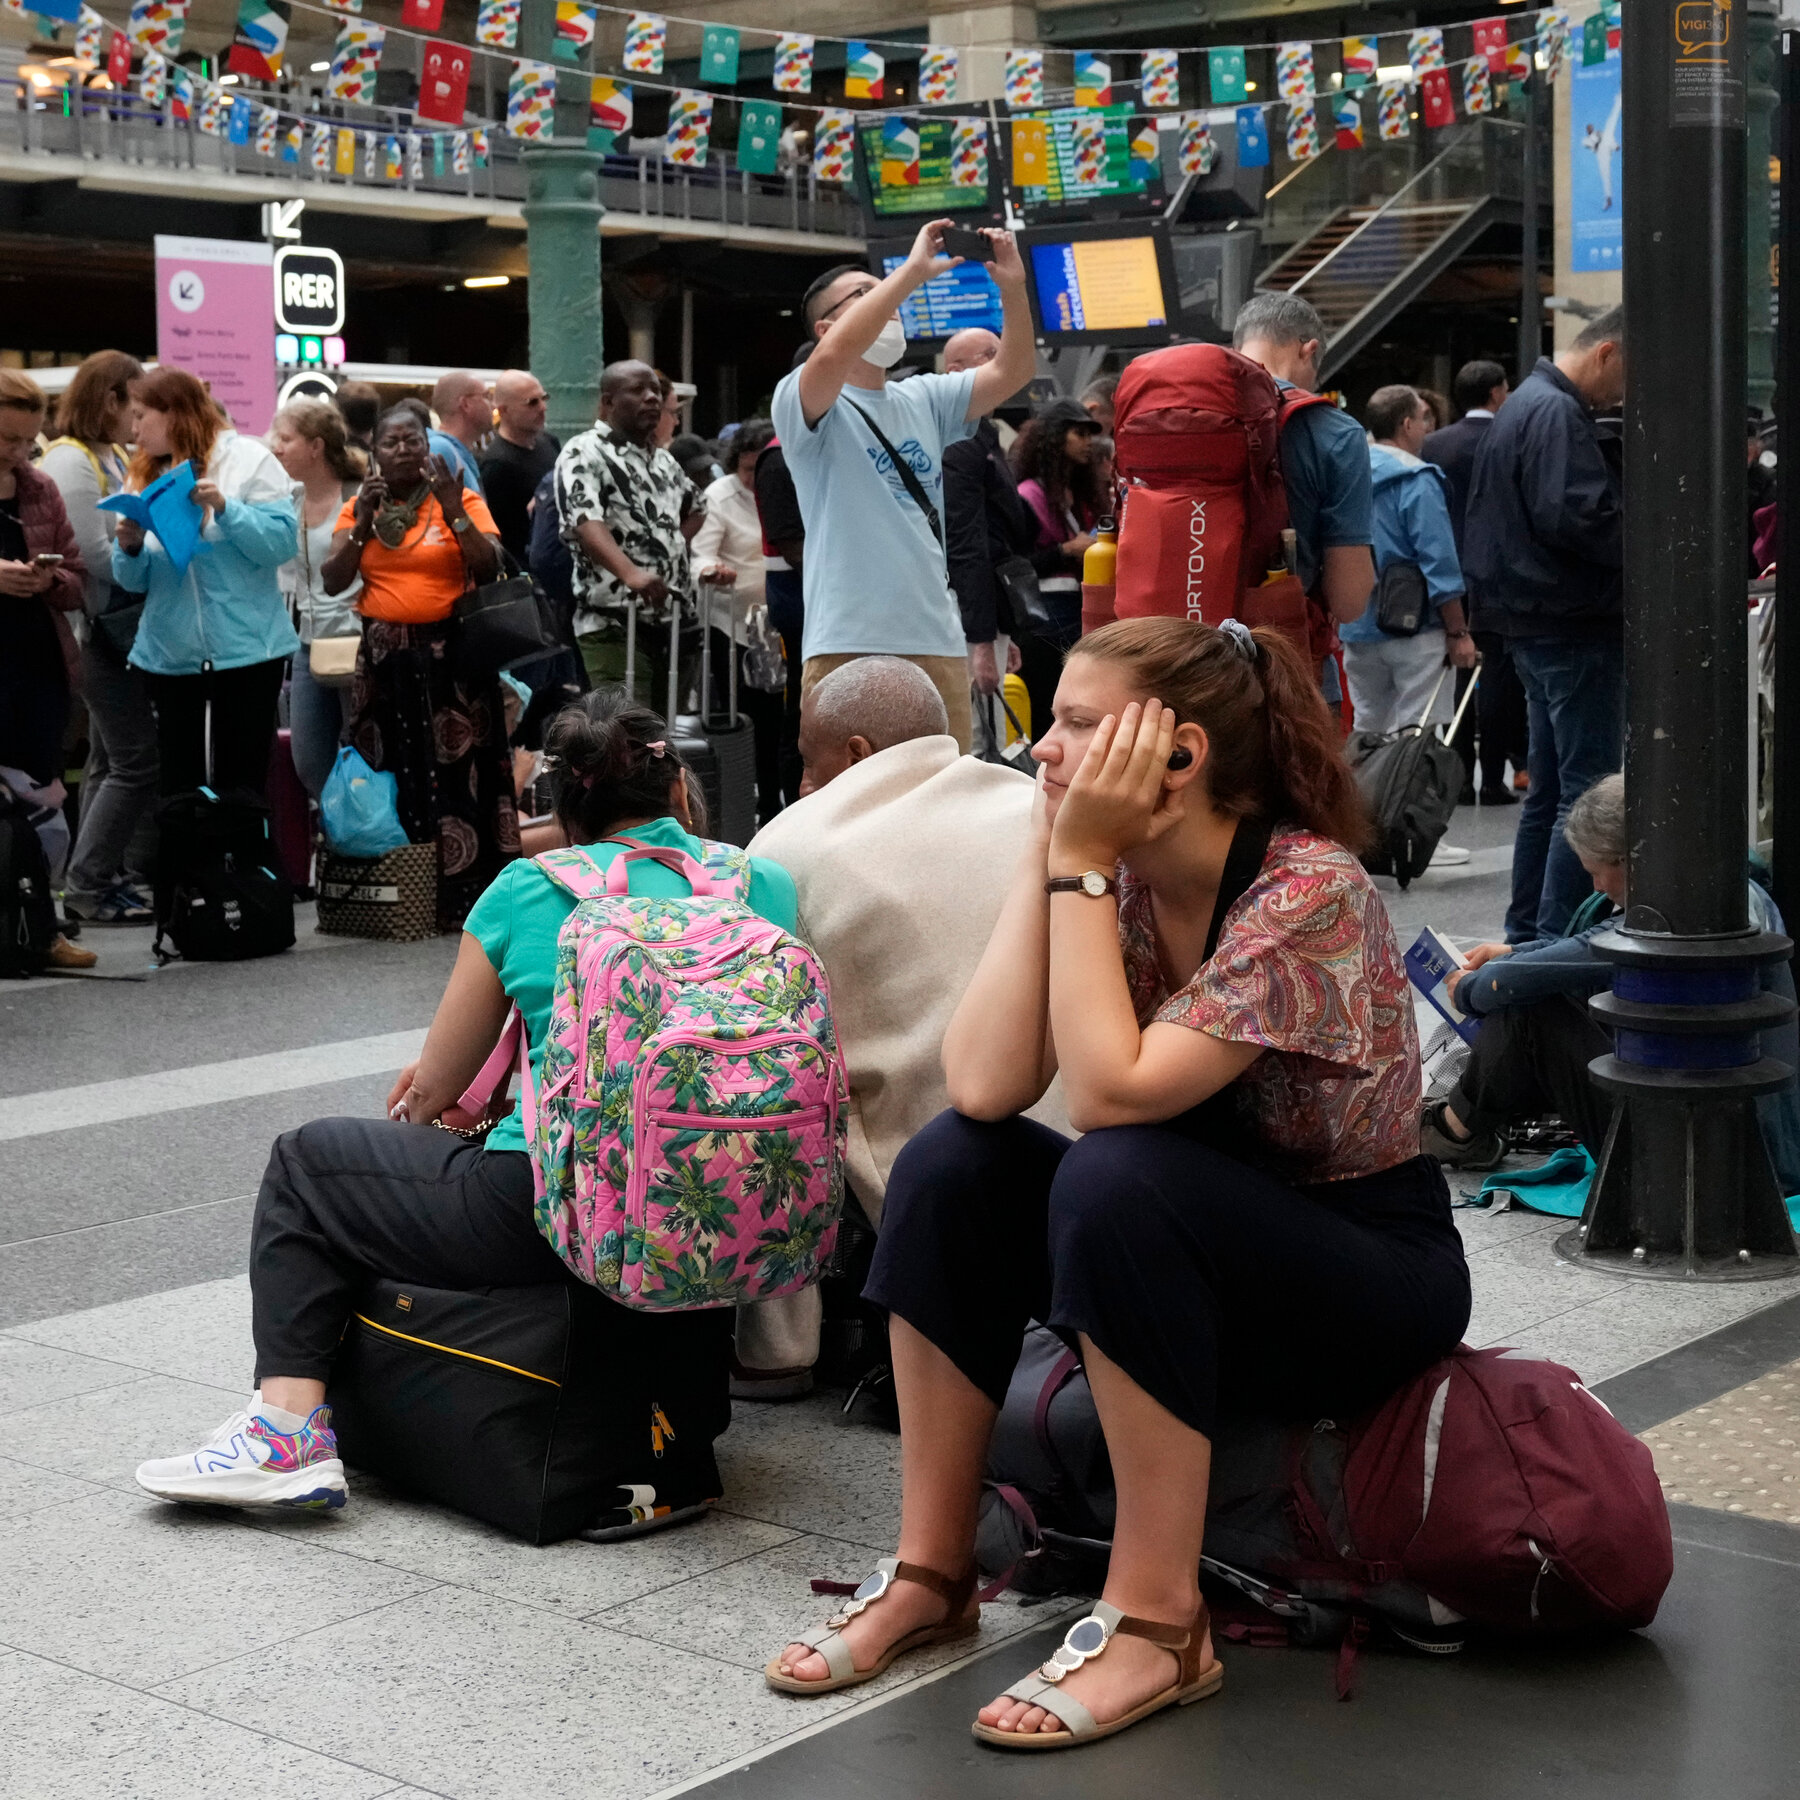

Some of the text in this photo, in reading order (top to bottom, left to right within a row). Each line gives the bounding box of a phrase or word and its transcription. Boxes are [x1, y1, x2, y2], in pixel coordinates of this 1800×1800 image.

[284, 272, 334, 309] RER
[1063, 247, 1085, 330] circulation
[1056, 292, 1072, 330] flash
[305, 340, 319, 359] D
